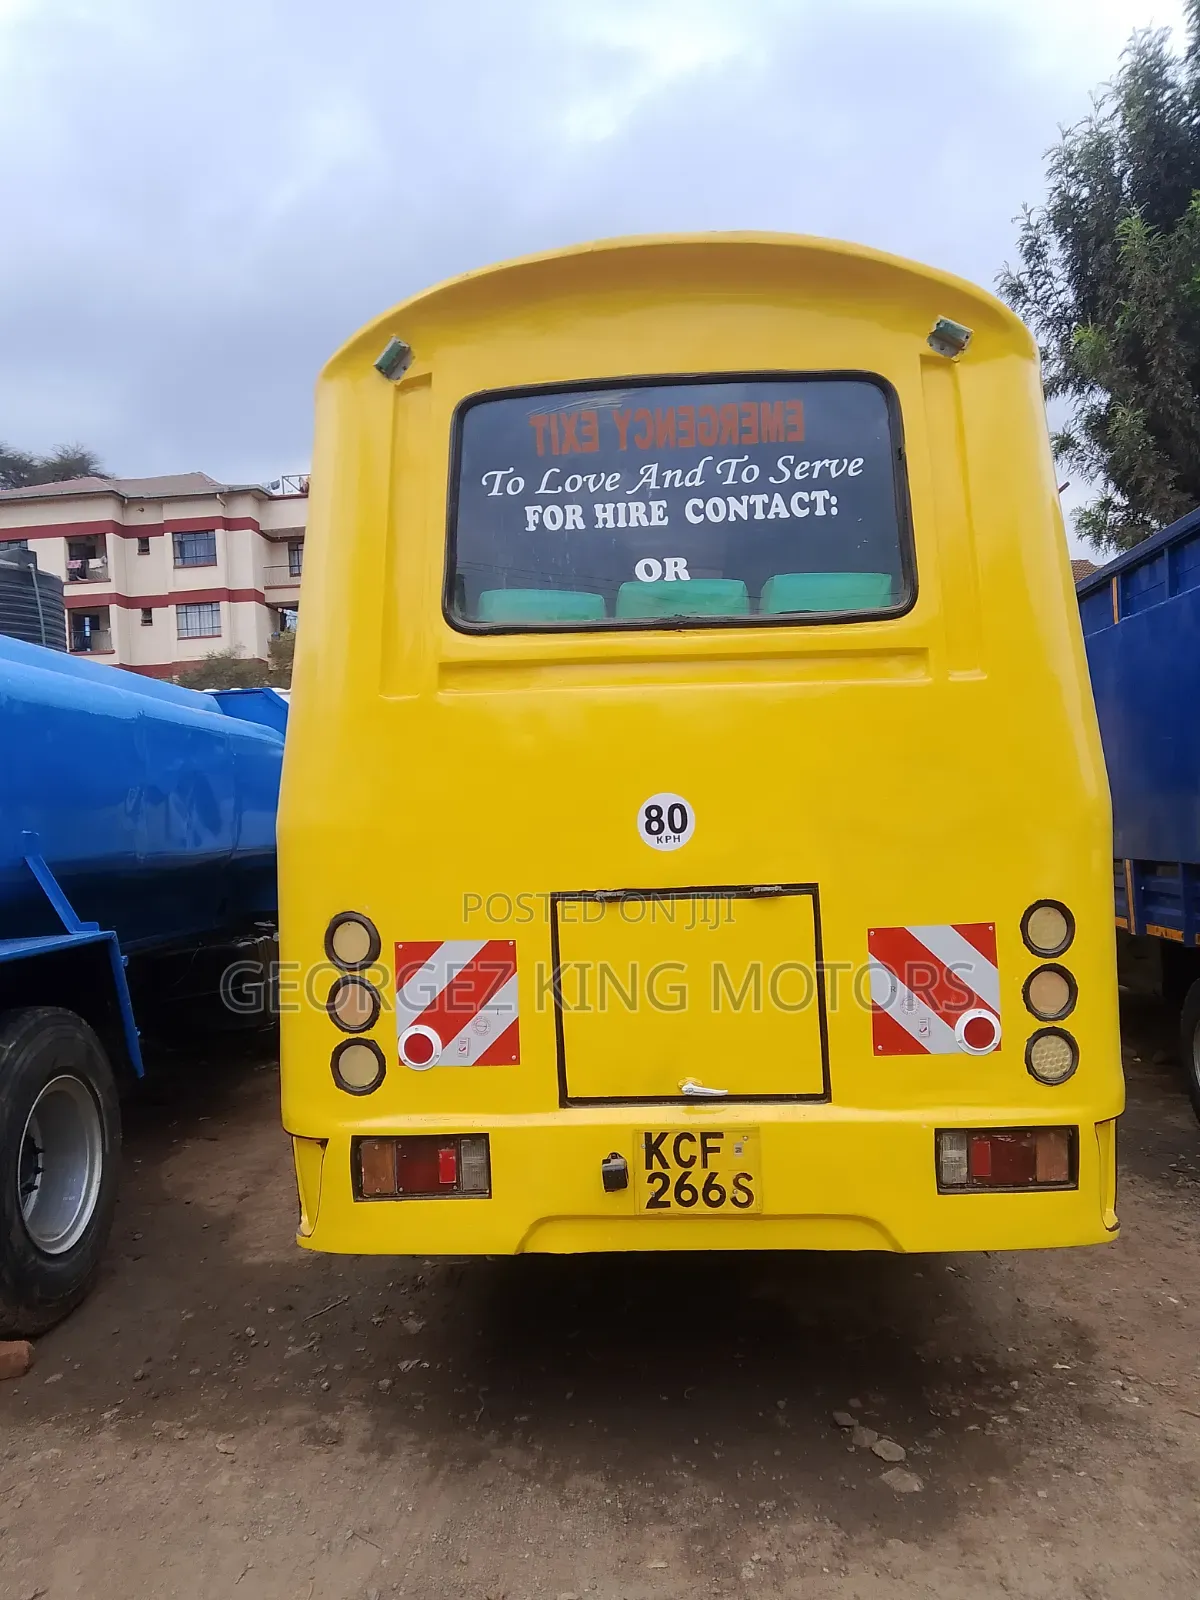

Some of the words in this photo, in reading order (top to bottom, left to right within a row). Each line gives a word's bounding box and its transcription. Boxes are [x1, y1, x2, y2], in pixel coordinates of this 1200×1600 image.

[481, 467, 525, 497] To
[535, 468, 620, 495] Love
[626, 456, 713, 494] And
[716, 455, 760, 485] To
[768, 454, 864, 483] Serve
[525, 503, 585, 532] FOR
[594, 500, 668, 529] HIRE
[685, 490, 838, 524] CONTACT:
[634, 557, 690, 583] OR
[645, 803, 688, 836] 80
[656, 834, 681, 844] KPH
[643, 1131, 725, 1170] KCF
[645, 1171, 755, 1209] 266S
